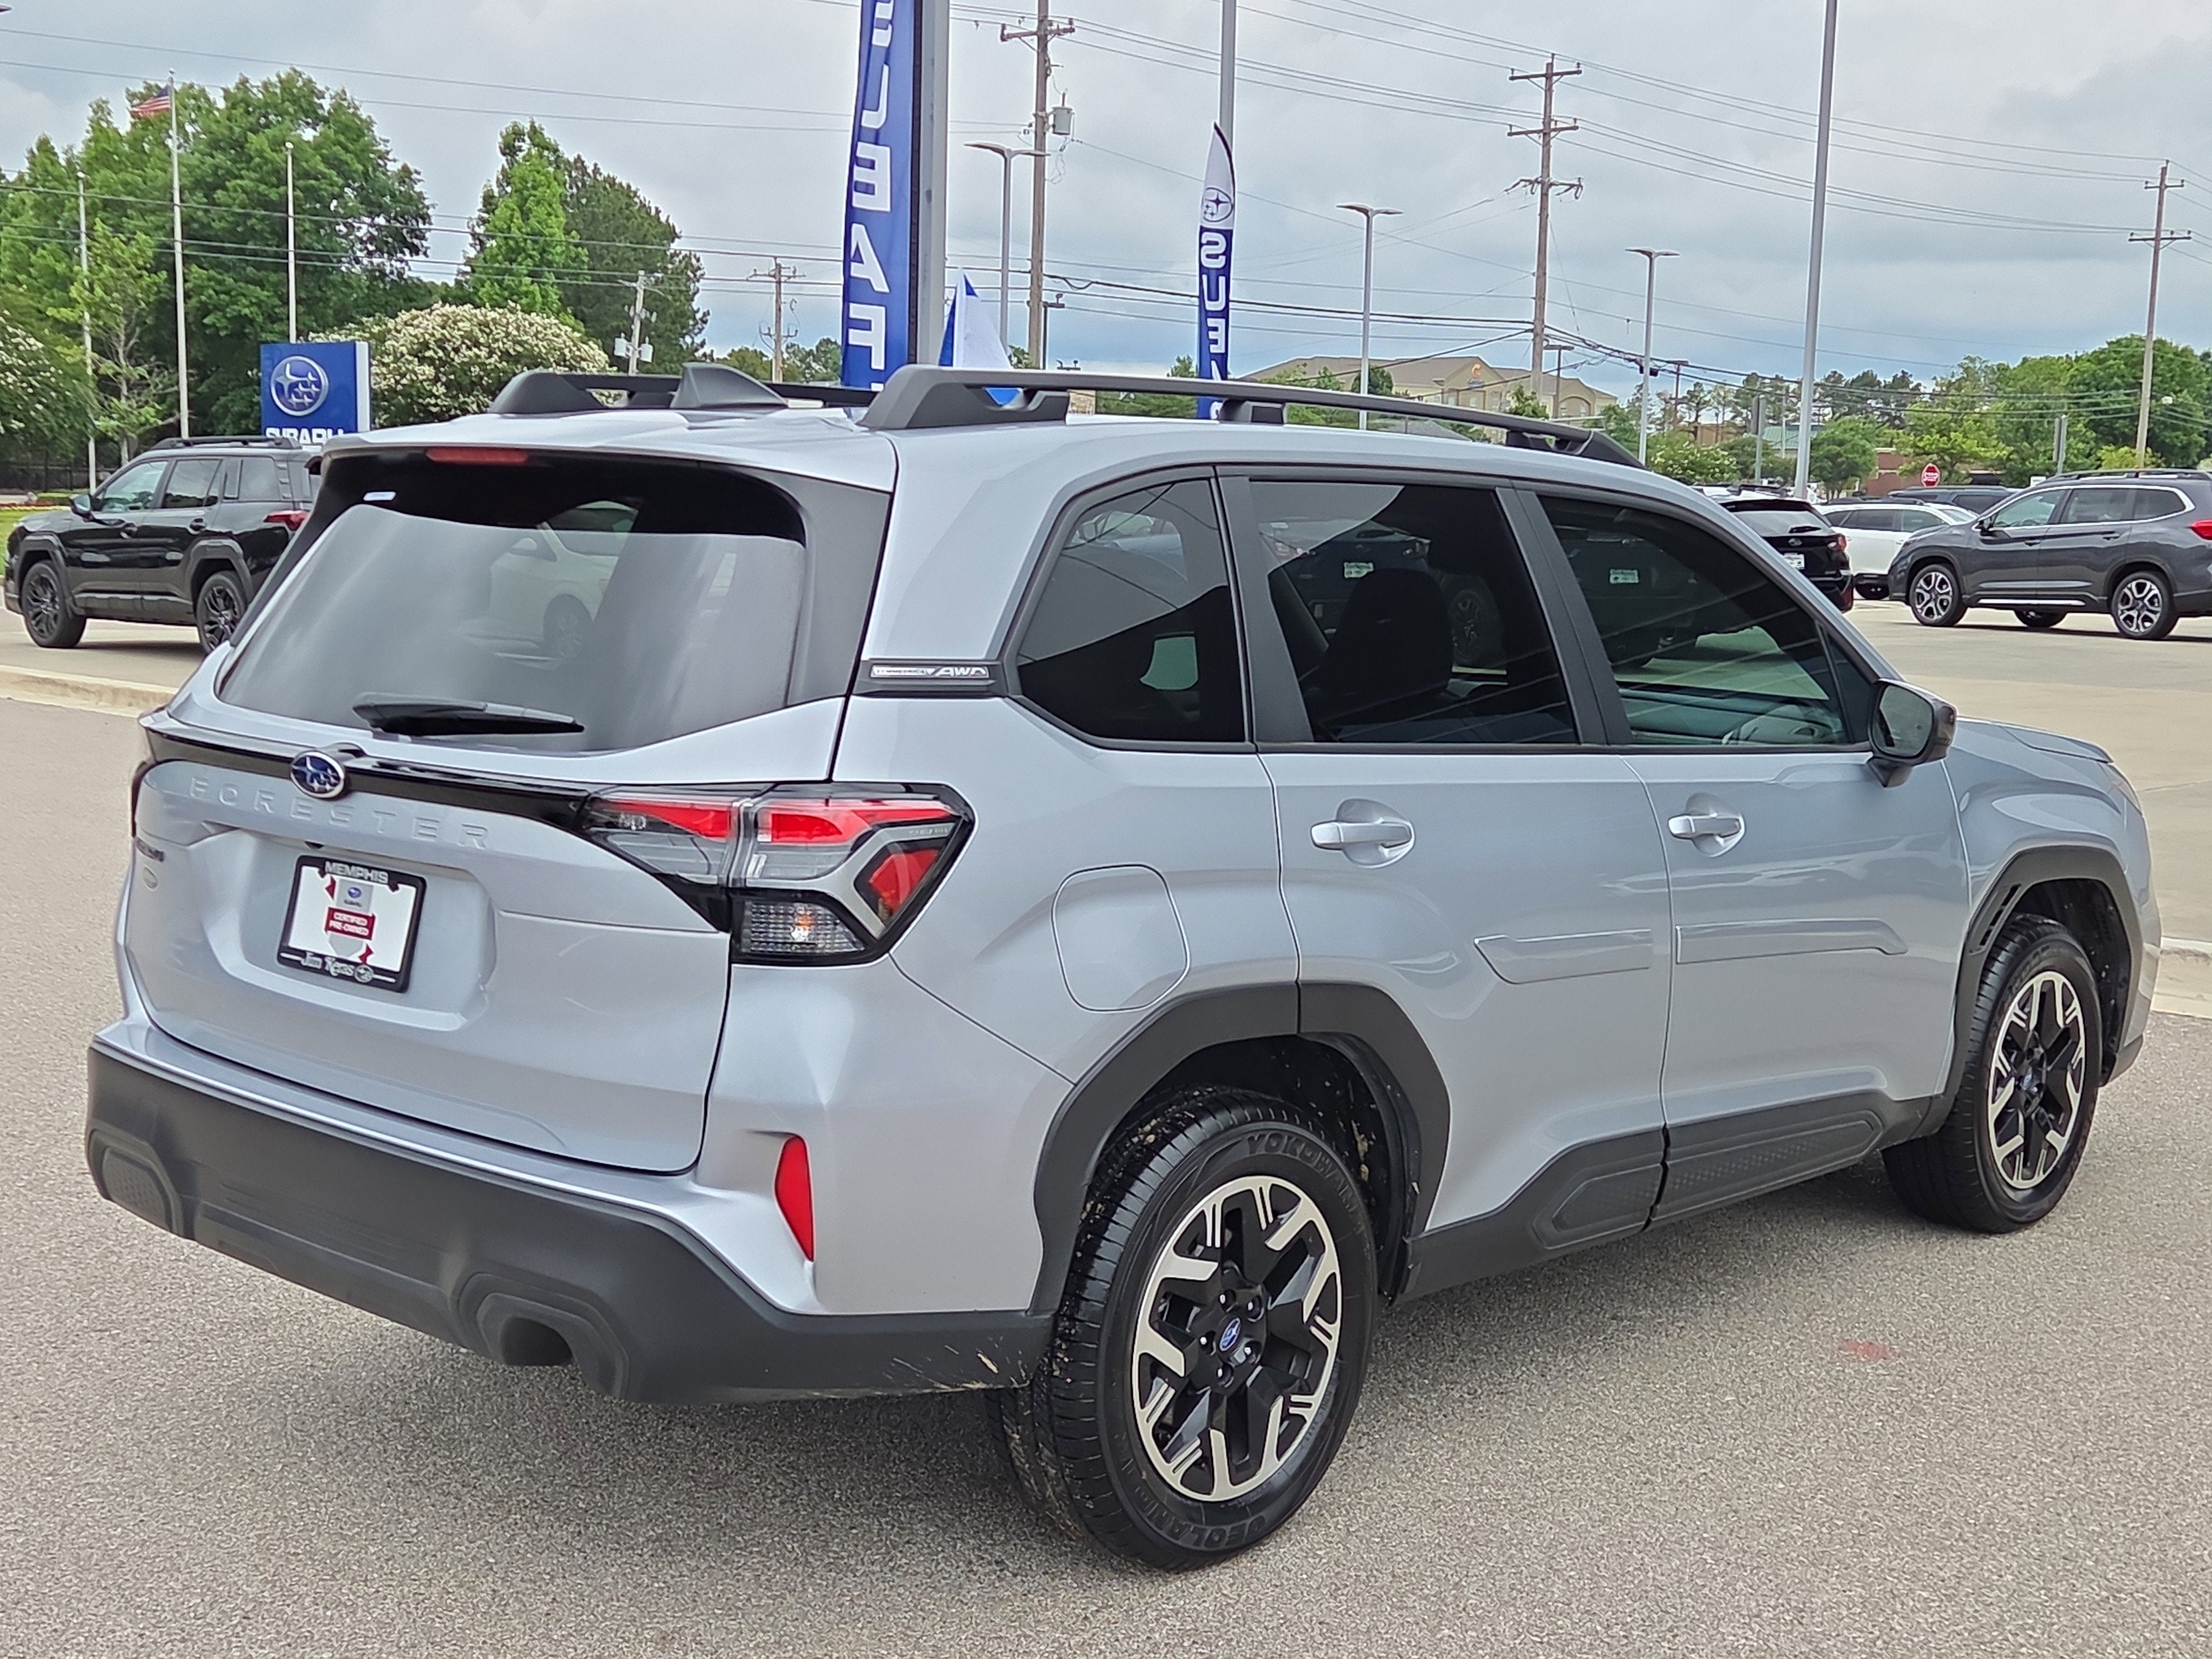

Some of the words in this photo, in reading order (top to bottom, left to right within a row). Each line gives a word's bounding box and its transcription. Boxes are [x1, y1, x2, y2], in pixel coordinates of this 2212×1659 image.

[935, 666, 987, 677] AWD
[189, 776, 488, 850] FORESTER
[325, 861, 389, 884] MEMPHIS
